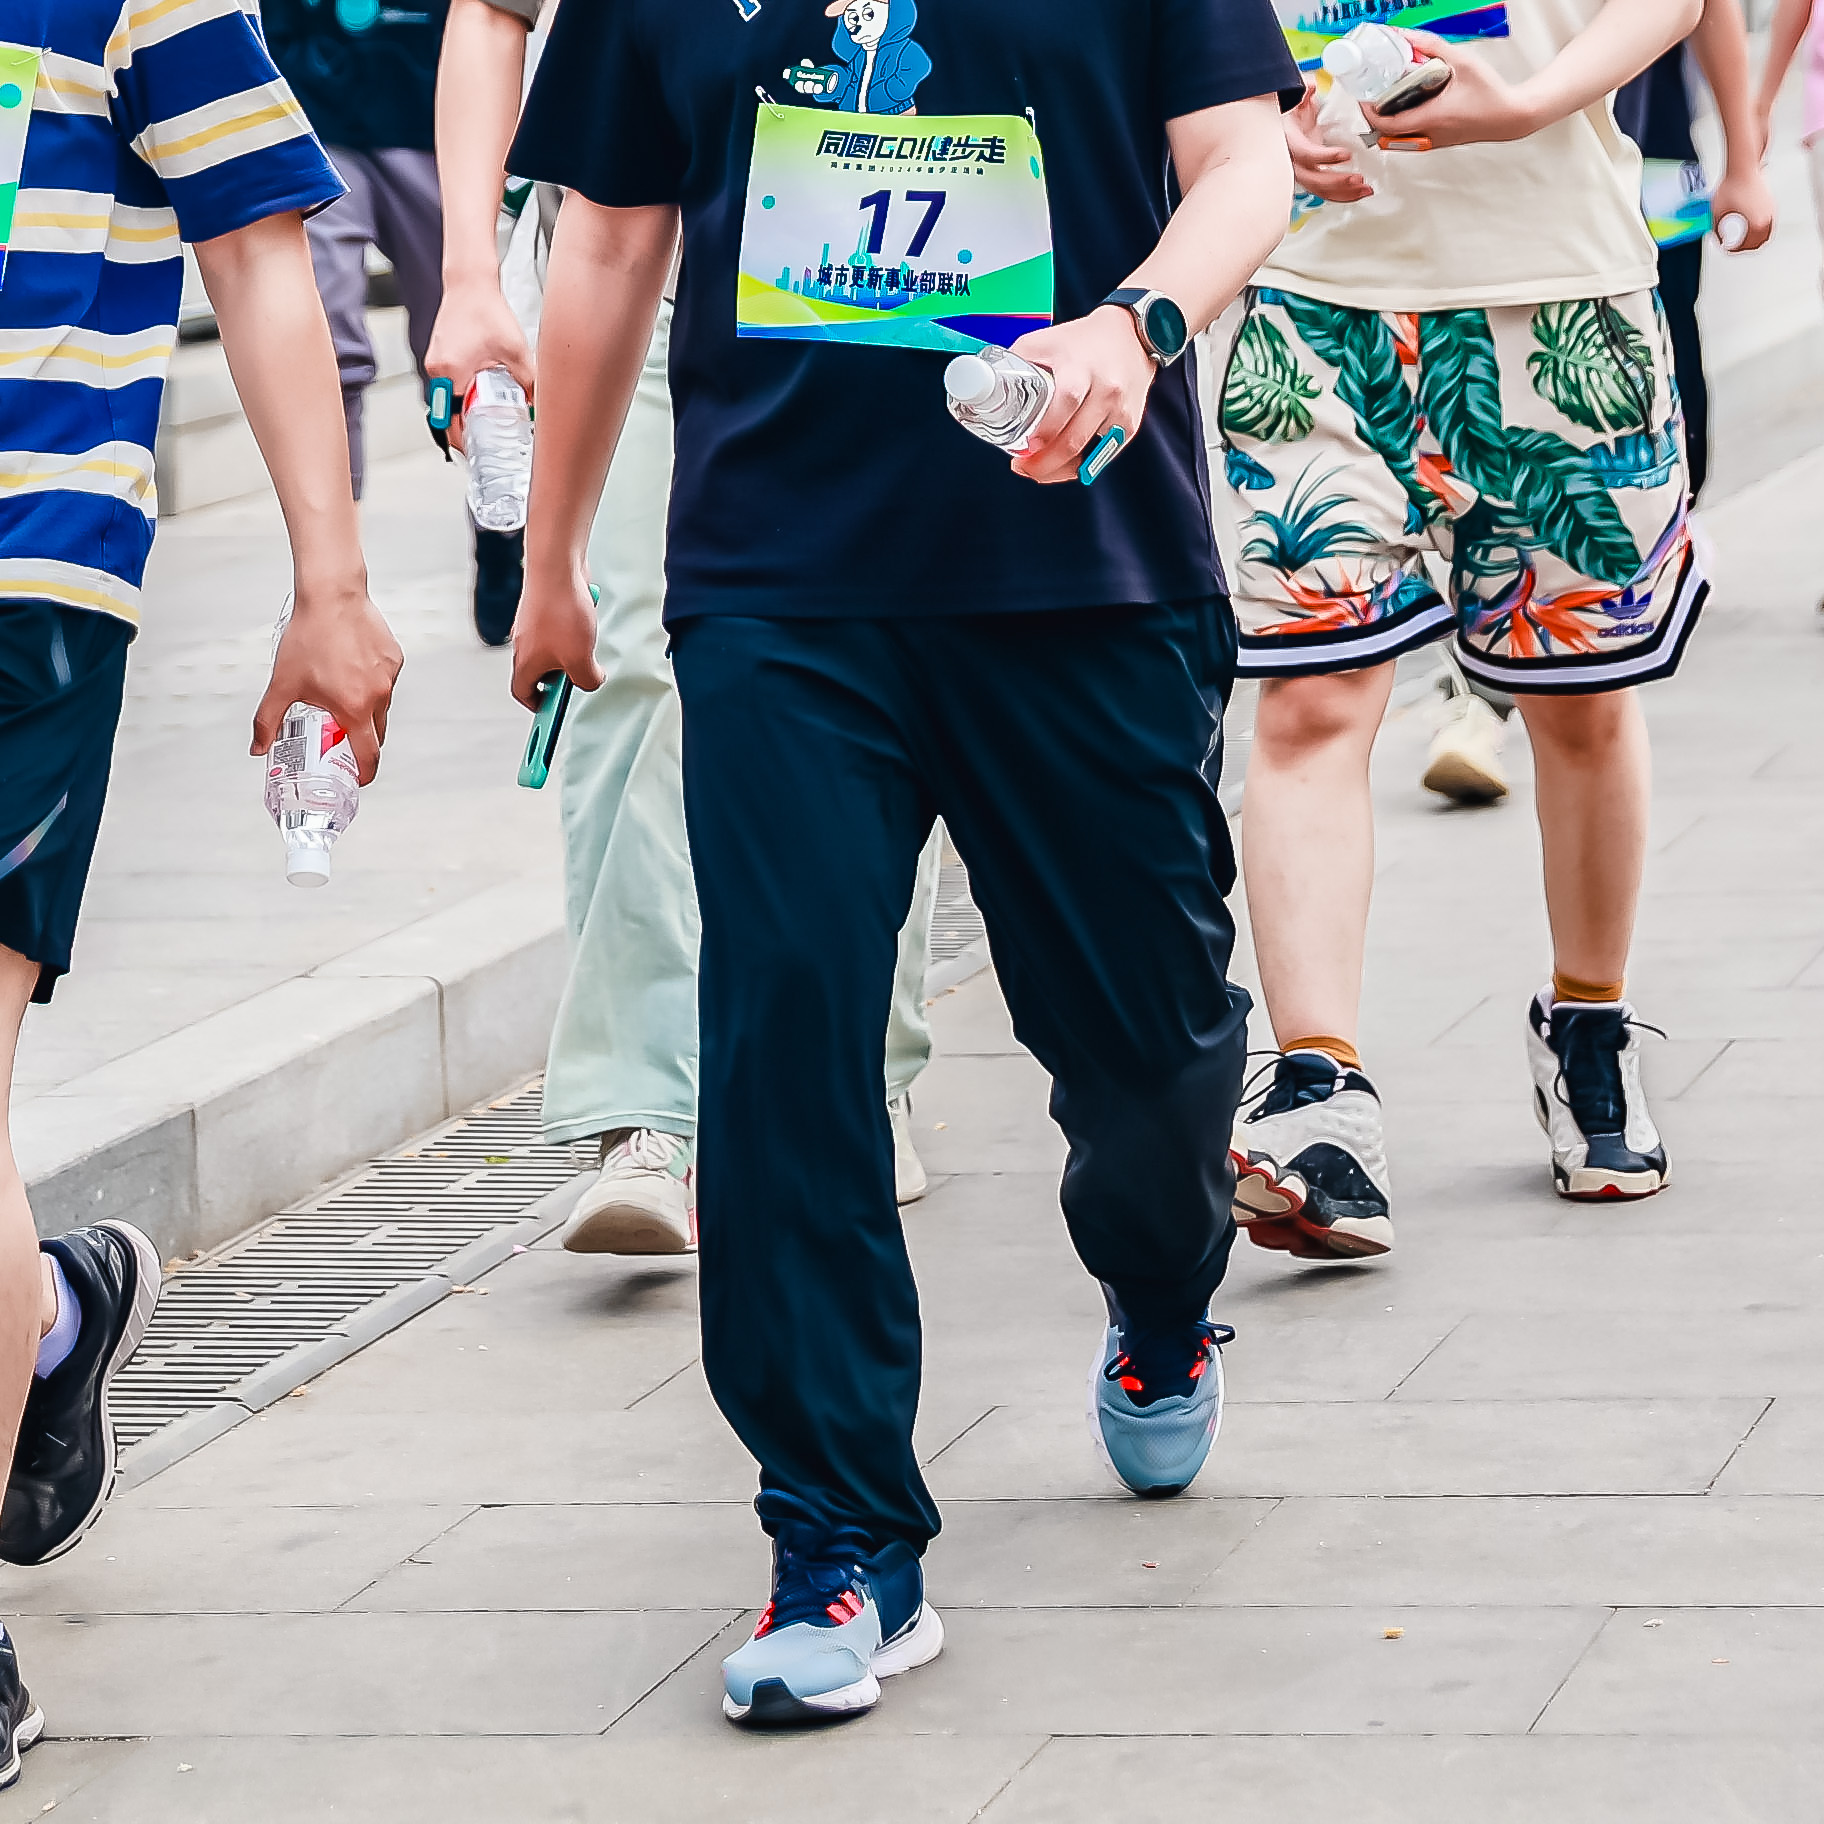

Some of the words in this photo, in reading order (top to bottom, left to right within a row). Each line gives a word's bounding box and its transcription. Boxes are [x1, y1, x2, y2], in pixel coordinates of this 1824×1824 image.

[815, 129, 1007, 165] 同圆GO!健步走
[859, 189, 947, 258] 17
[817, 263, 971, 297] 城市更新事业部联队
